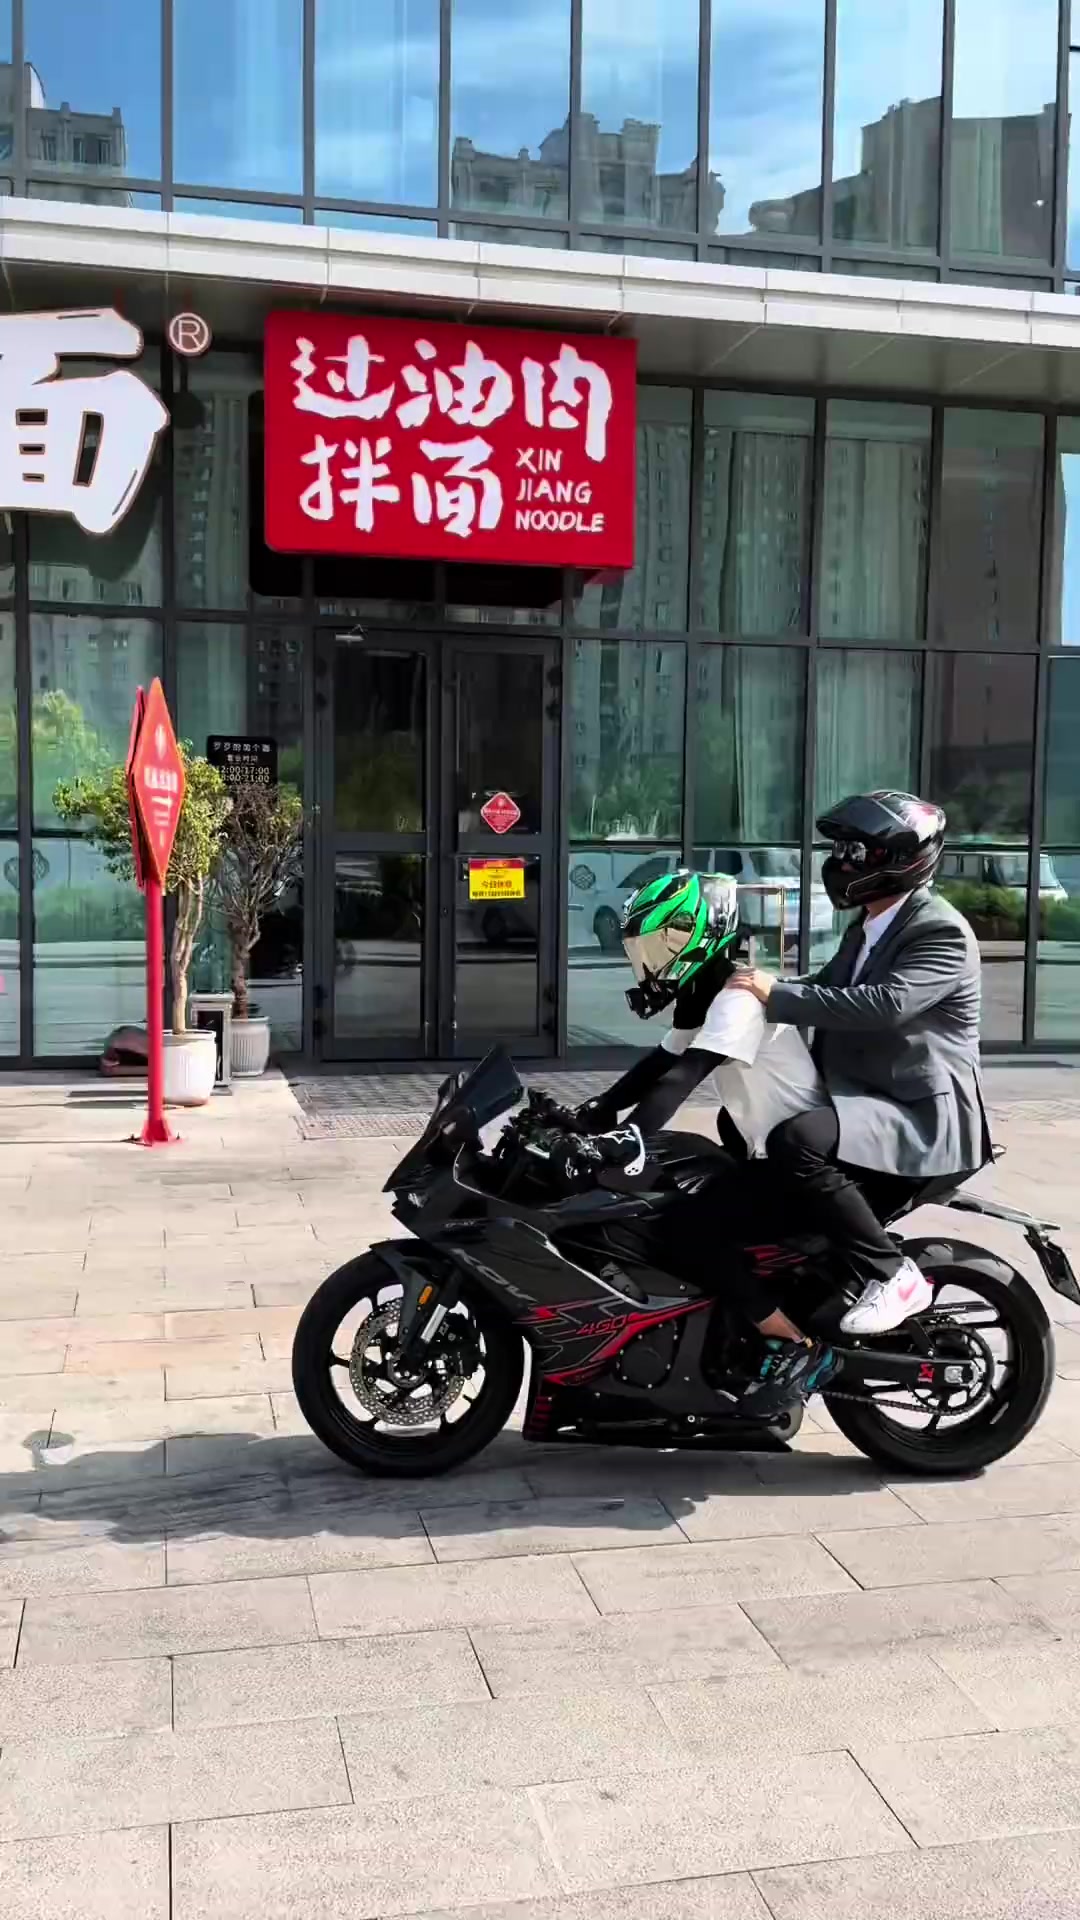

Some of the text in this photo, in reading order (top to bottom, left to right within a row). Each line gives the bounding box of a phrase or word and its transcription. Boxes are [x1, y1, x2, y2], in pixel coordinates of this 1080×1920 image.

[291, 335, 613, 462] 过油肉
[515, 447, 562, 474] XIN
[299, 434, 504, 539] 拌面
[516, 479, 592, 504] JIANG
[515, 510, 605, 533] NOODLE
